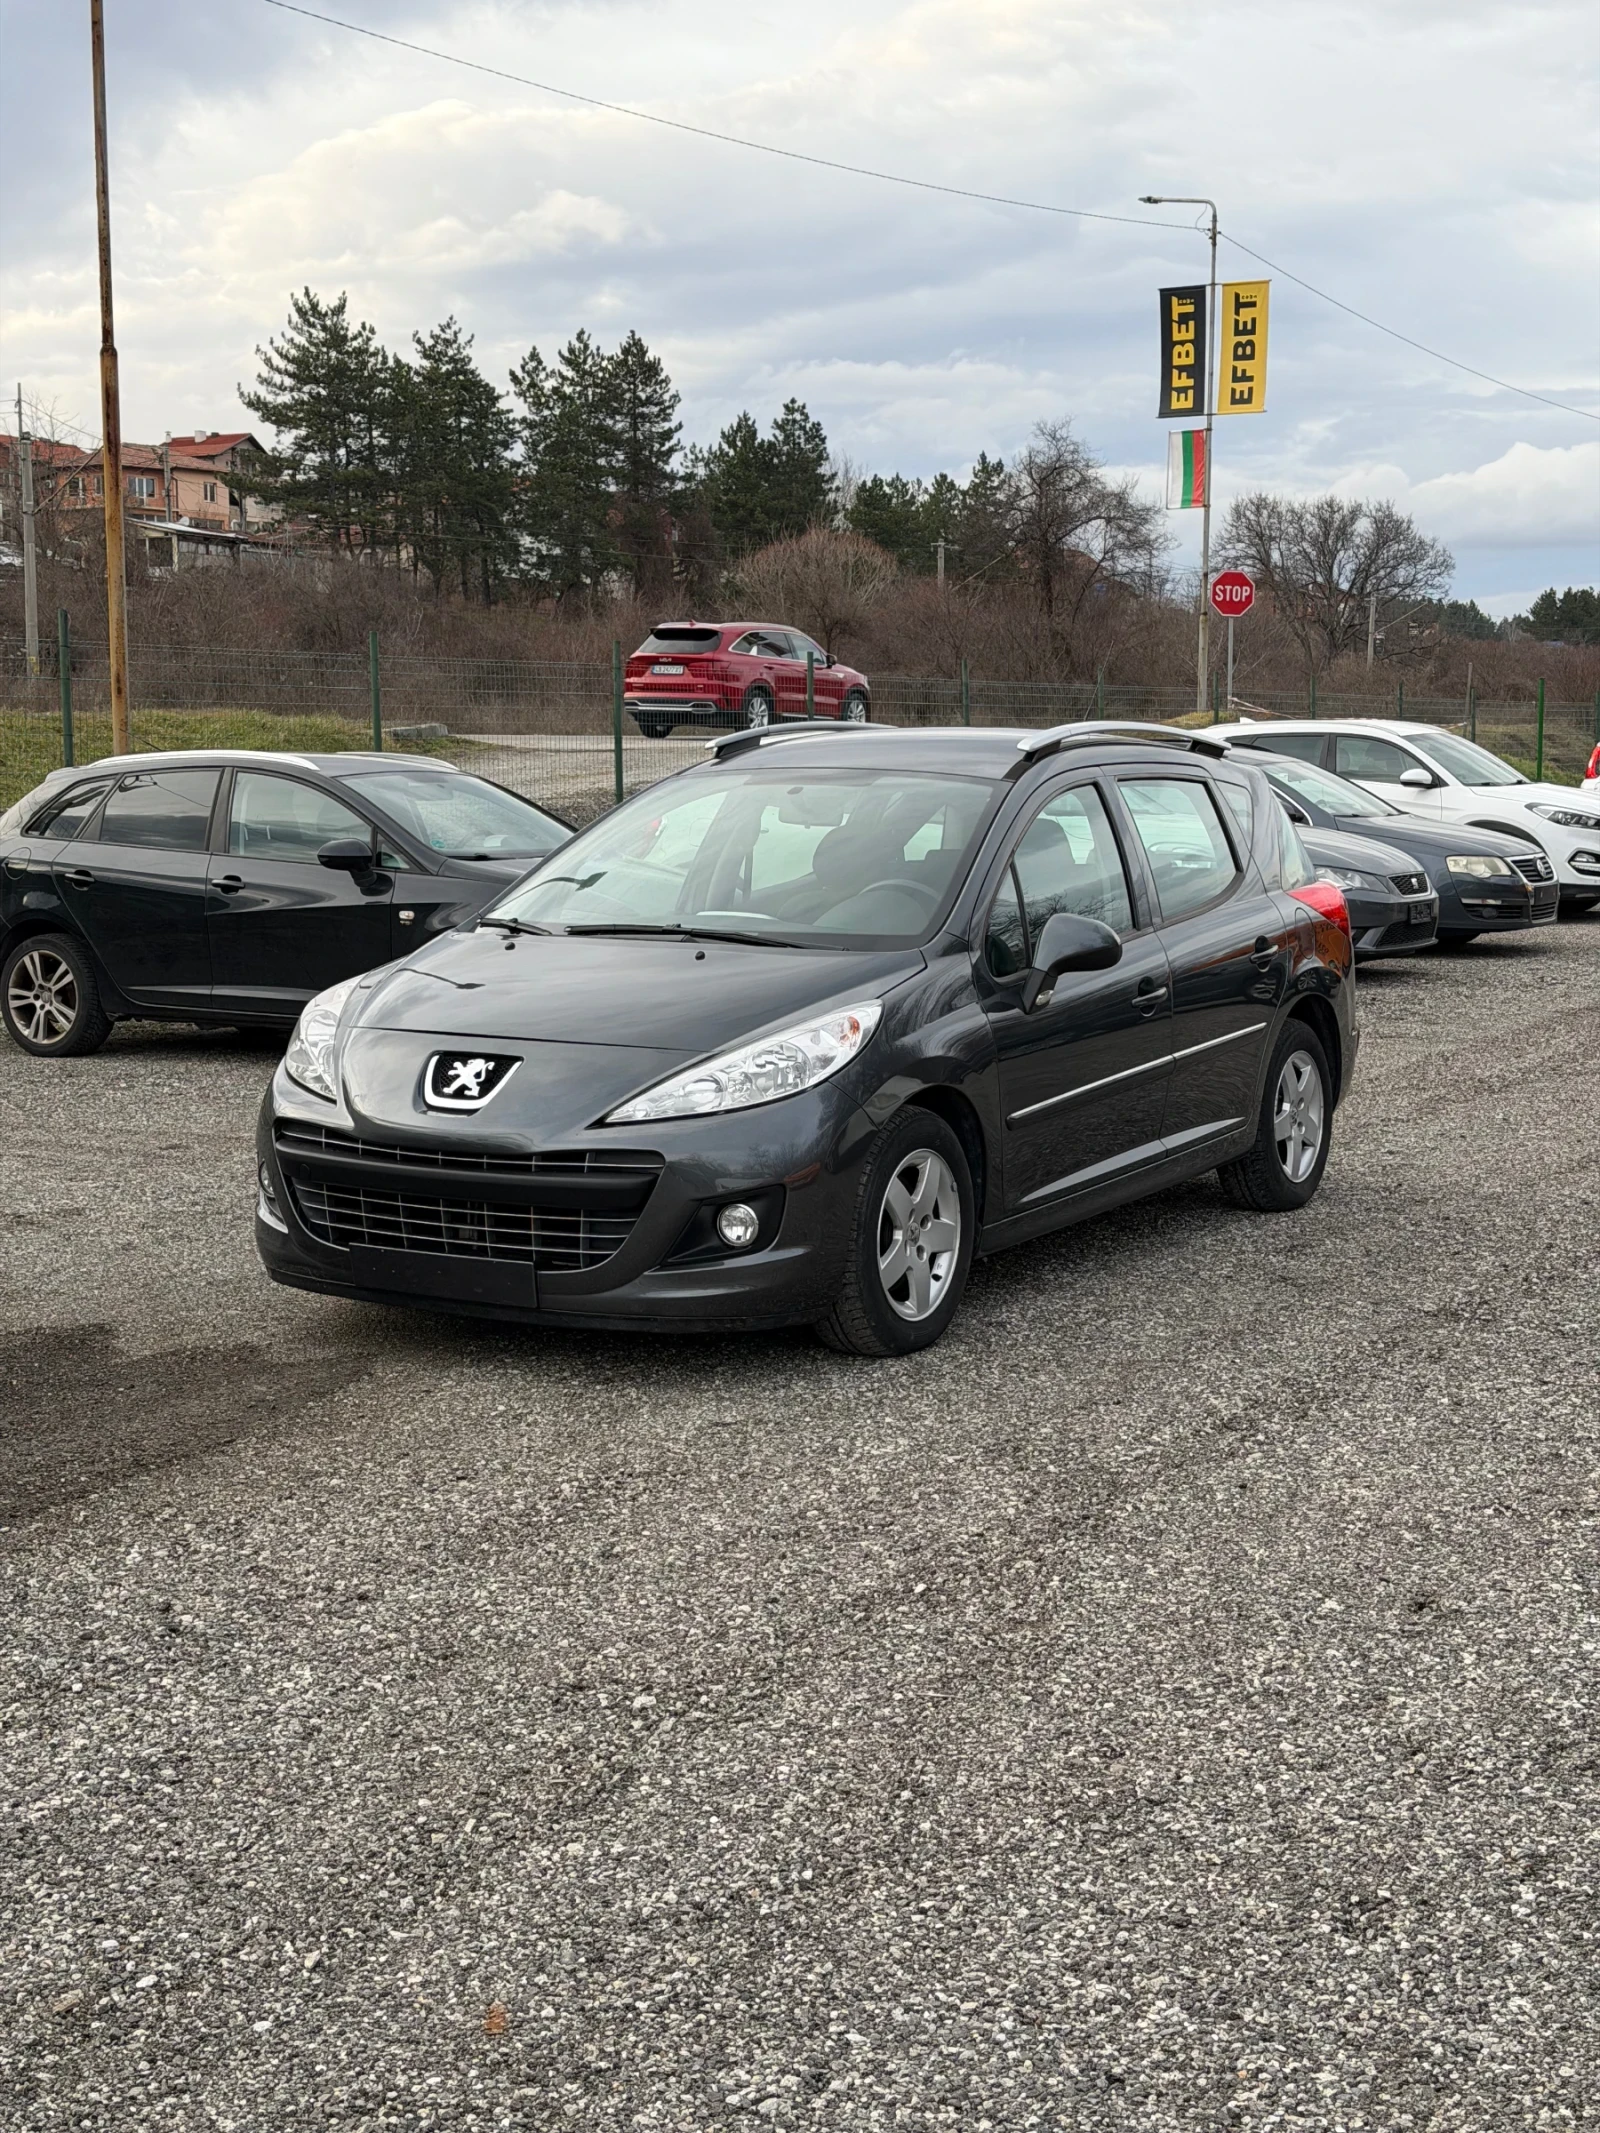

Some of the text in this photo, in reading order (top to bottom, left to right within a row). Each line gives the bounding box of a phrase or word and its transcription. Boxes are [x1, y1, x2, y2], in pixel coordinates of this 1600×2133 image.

[1171, 296, 1194, 409] EFBET
[1230, 291, 1257, 406] EFBET
[1215, 585, 1250, 601] STOP
